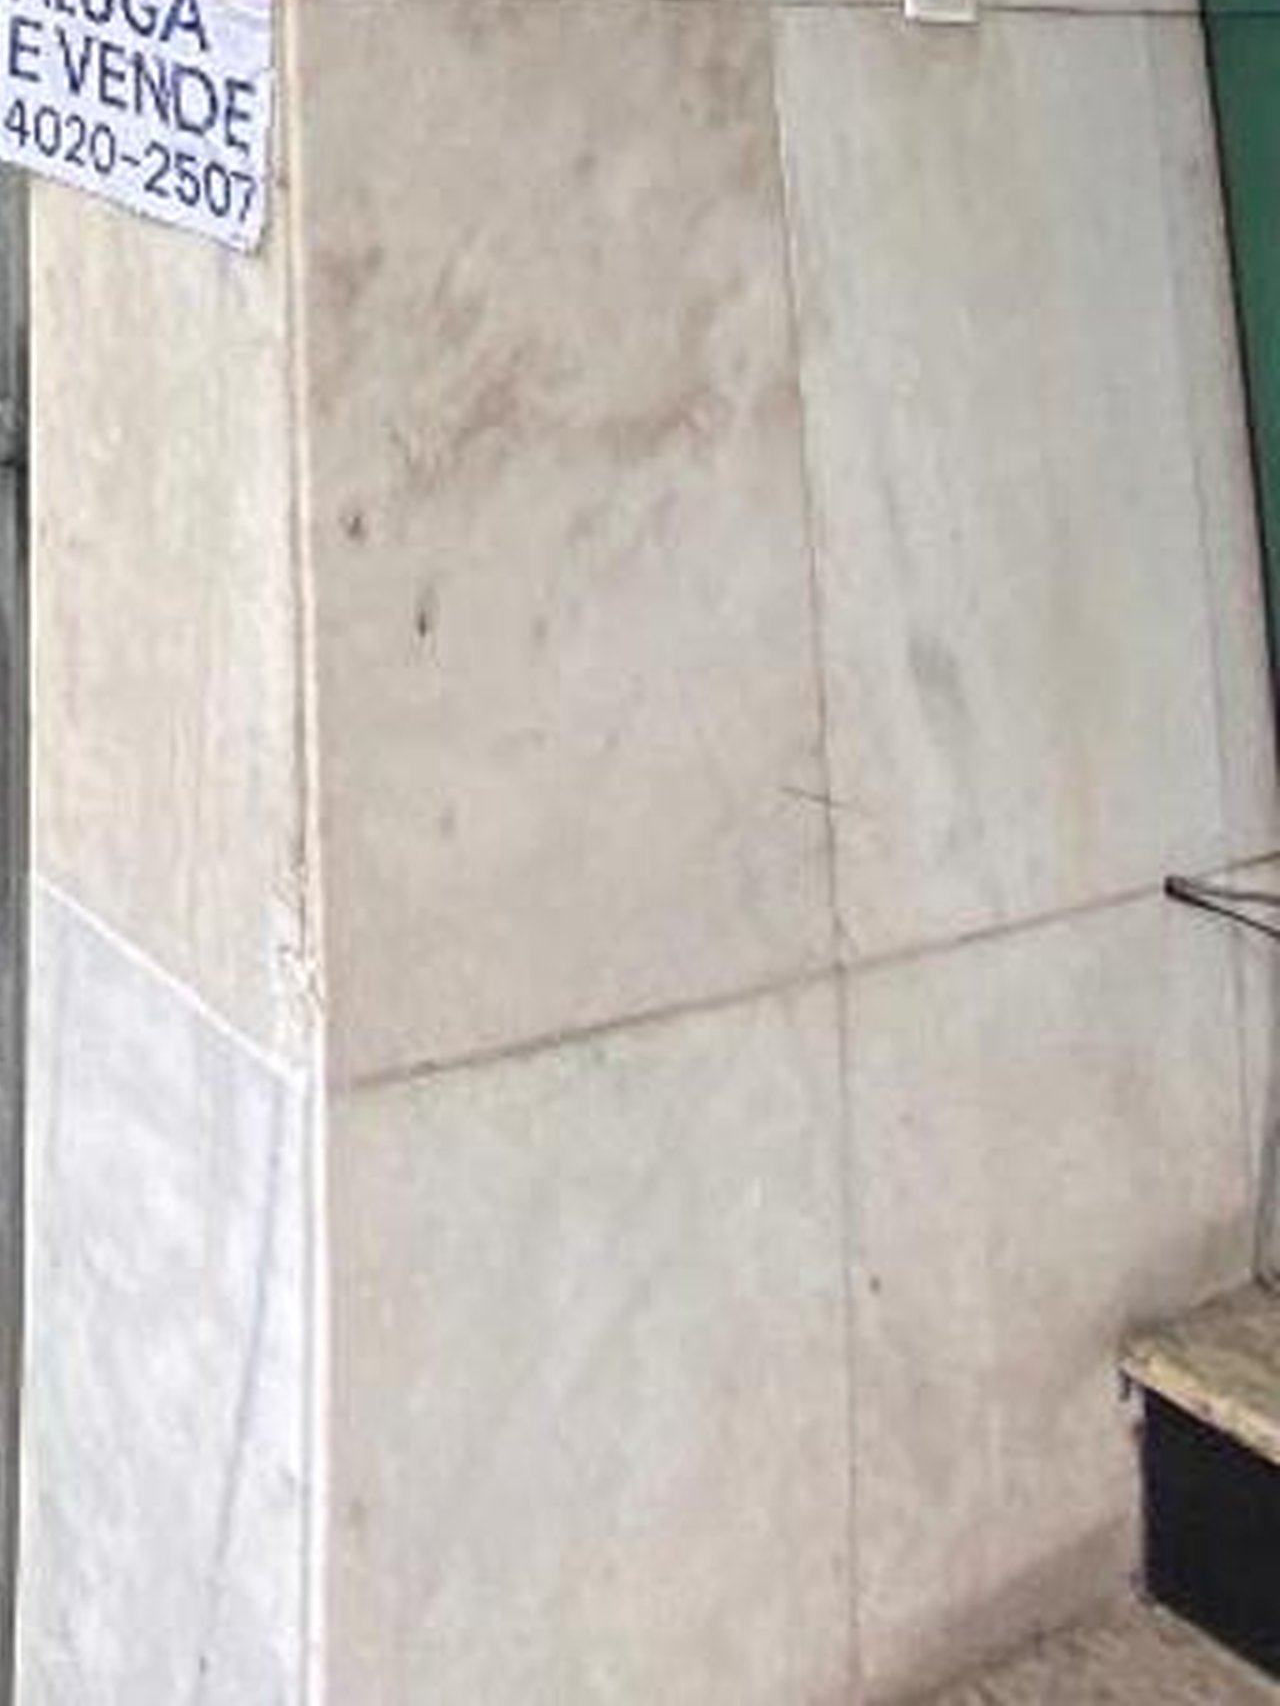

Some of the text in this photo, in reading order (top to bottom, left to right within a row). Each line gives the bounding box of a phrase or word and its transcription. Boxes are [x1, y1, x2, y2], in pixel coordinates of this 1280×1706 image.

[8, 16, 257, 157] E VENDE
[3, 98, 258, 222] 4020-2507
